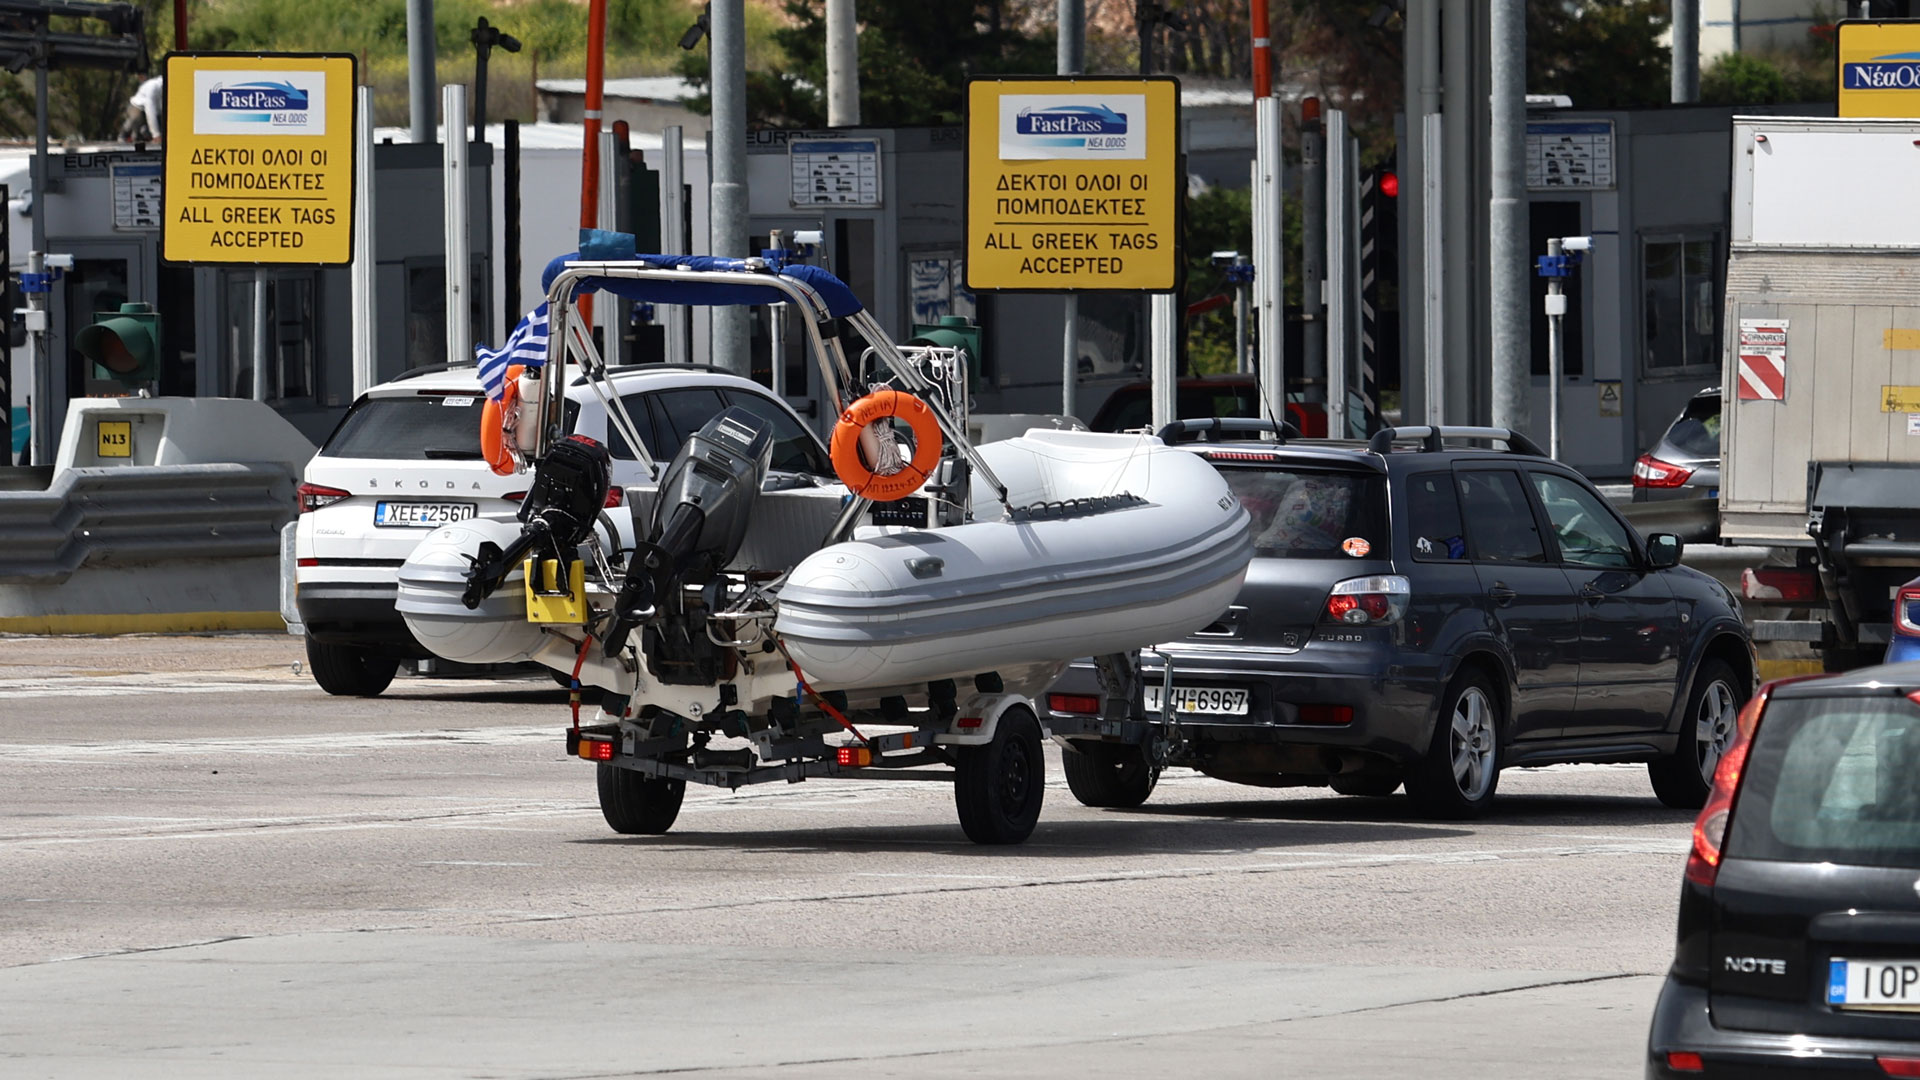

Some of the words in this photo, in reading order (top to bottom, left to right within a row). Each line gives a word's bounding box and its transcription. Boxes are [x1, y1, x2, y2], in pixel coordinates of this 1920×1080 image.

[221, 91, 286, 108] FastPass
[272, 113, 287, 123] NEA
[288, 113, 308, 123] ODOS
[1030, 115, 1102, 133] FastPass
[1087, 137, 1103, 147] NEA
[1105, 137, 1127, 148] ODOS
[191, 148, 254, 165] ΔΕΚΤΟΙ
[262, 149, 303, 166] ΟΛΟΙ
[310, 149, 328, 166] ΟΙ
[191, 172, 325, 190] ΠΟΜΠΟΔΕΚΤΕΣ
[996, 174, 1067, 191] ΔΕΚΤΟΙ
[1075, 174, 1121, 191] ΟΛΟΙ
[1130, 174, 1148, 191] ΟΙ
[997, 198, 1146, 215] ΠΟΜΠΟΔΕΚΤΕΣ
[179, 206, 214, 223] ALL
[222, 207, 282, 224] GREEK
[291, 208, 336, 225] TAGS
[210, 231, 304, 248] ACCEPTED
[984, 232, 1022, 249] ALL
[1032, 233, 1099, 250] GREEK
[1109, 233, 1158, 250] TAGS
[1019, 257, 1123, 274] ACCEPTED
[103, 433, 126, 444] N13
[1318, 633, 1363, 642] TURBO
[1725, 956, 1787, 975] NOTE
